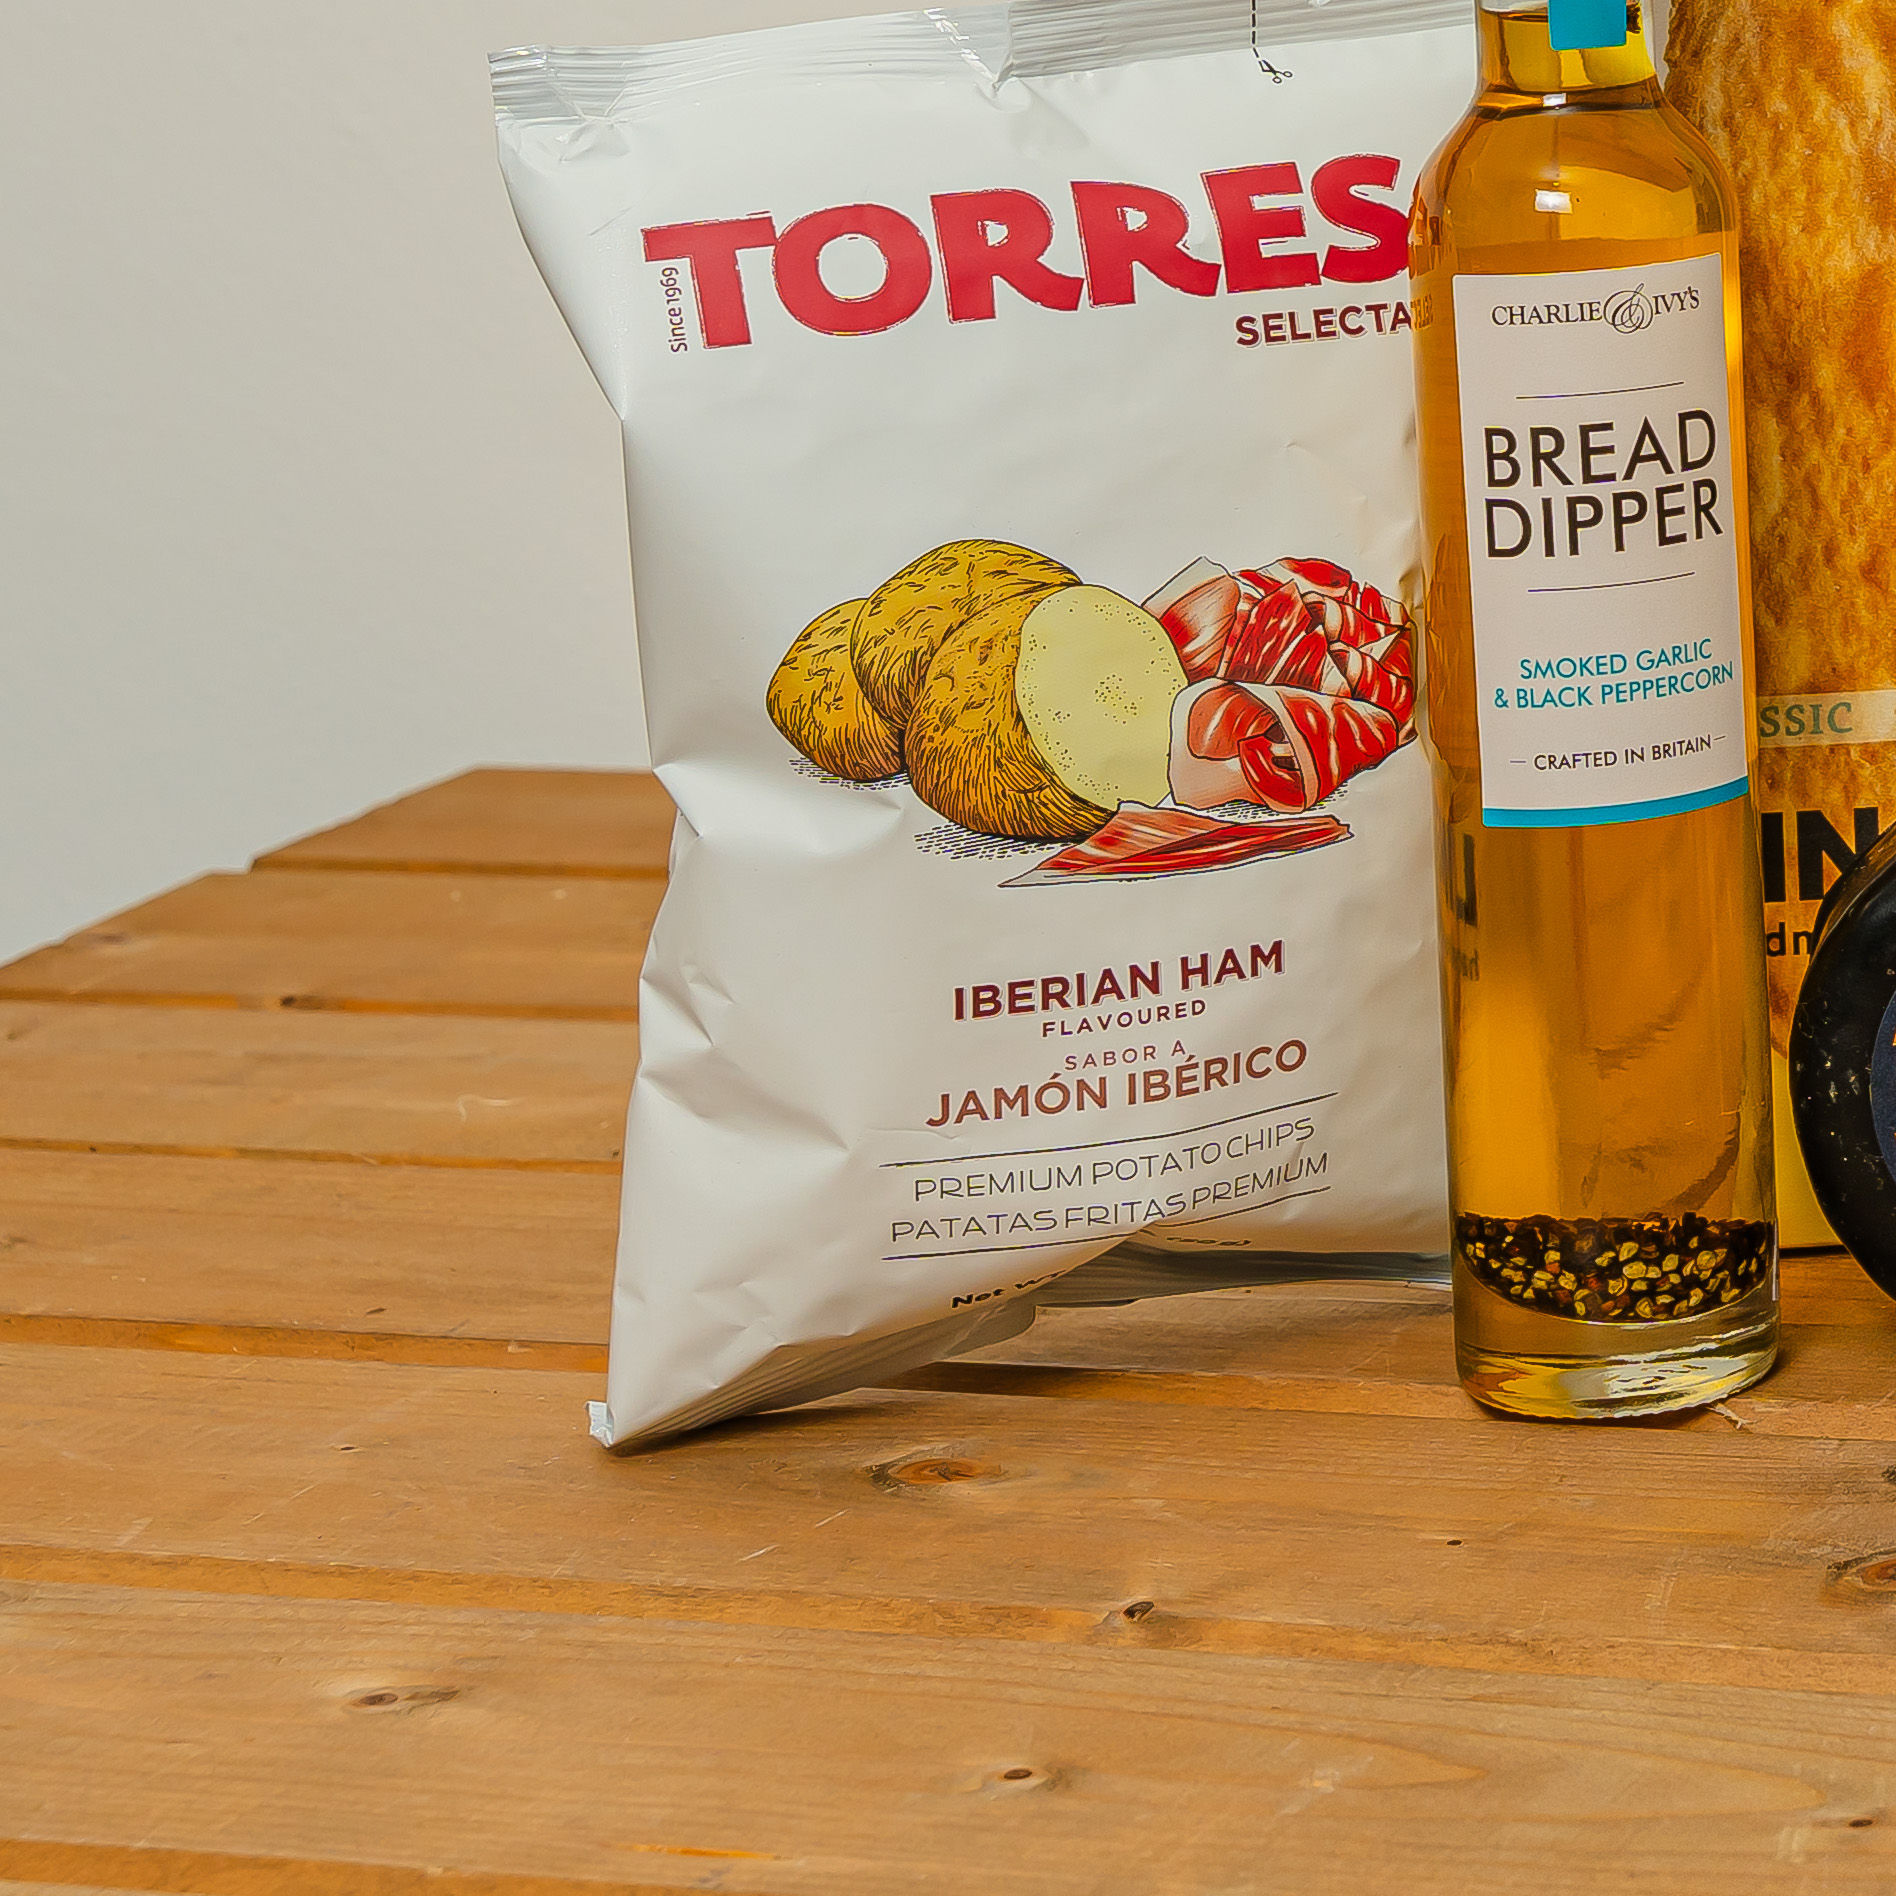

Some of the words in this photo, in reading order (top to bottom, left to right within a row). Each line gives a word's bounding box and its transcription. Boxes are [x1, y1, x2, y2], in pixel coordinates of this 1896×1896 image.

[641, 153, 1411, 352] TORRES
[1235, 301, 1412, 347] SELECTA
[1491, 300, 1602, 327] CHARLIE
[1654, 286, 1700, 316] IVY'S
[1484, 409, 1717, 487] BREAD
[1484, 478, 1723, 558] DIPPER
[1493, 689, 1509, 709] &
[1517, 681, 1593, 709] BLACK
[1601, 661, 1734, 705] PEPPERCORN
[1519, 654, 1628, 680] SMOKED
[1635, 637, 1713, 673] GARLIC
[1533, 749, 1618, 771] CRAFTED
[1623, 744, 1645, 765] IN
[1651, 735, 1712, 761] BRITAIN
[953, 958, 1162, 1023] IBERIAN
[1179, 938, 1286, 991] HAM
[1042, 998, 1206, 1039] FLAVOURED
[927, 1071, 1109, 1128] JAMÓN
[1128, 1039, 1307, 1105] IBÉRICO
[1065, 1044, 1156, 1071] SABOR
[1170, 1038, 1187, 1059] A
[914, 1163, 1083, 1203] PREMIUM
[1090, 1141, 1222, 1188] POTATO
[1229, 1116, 1315, 1162] CHIPS
[891, 1206, 1058, 1243] PATATAS
[1065, 1191, 1188, 1229] FRITAS
[1191, 1153, 1329, 1214] PREMIUM
